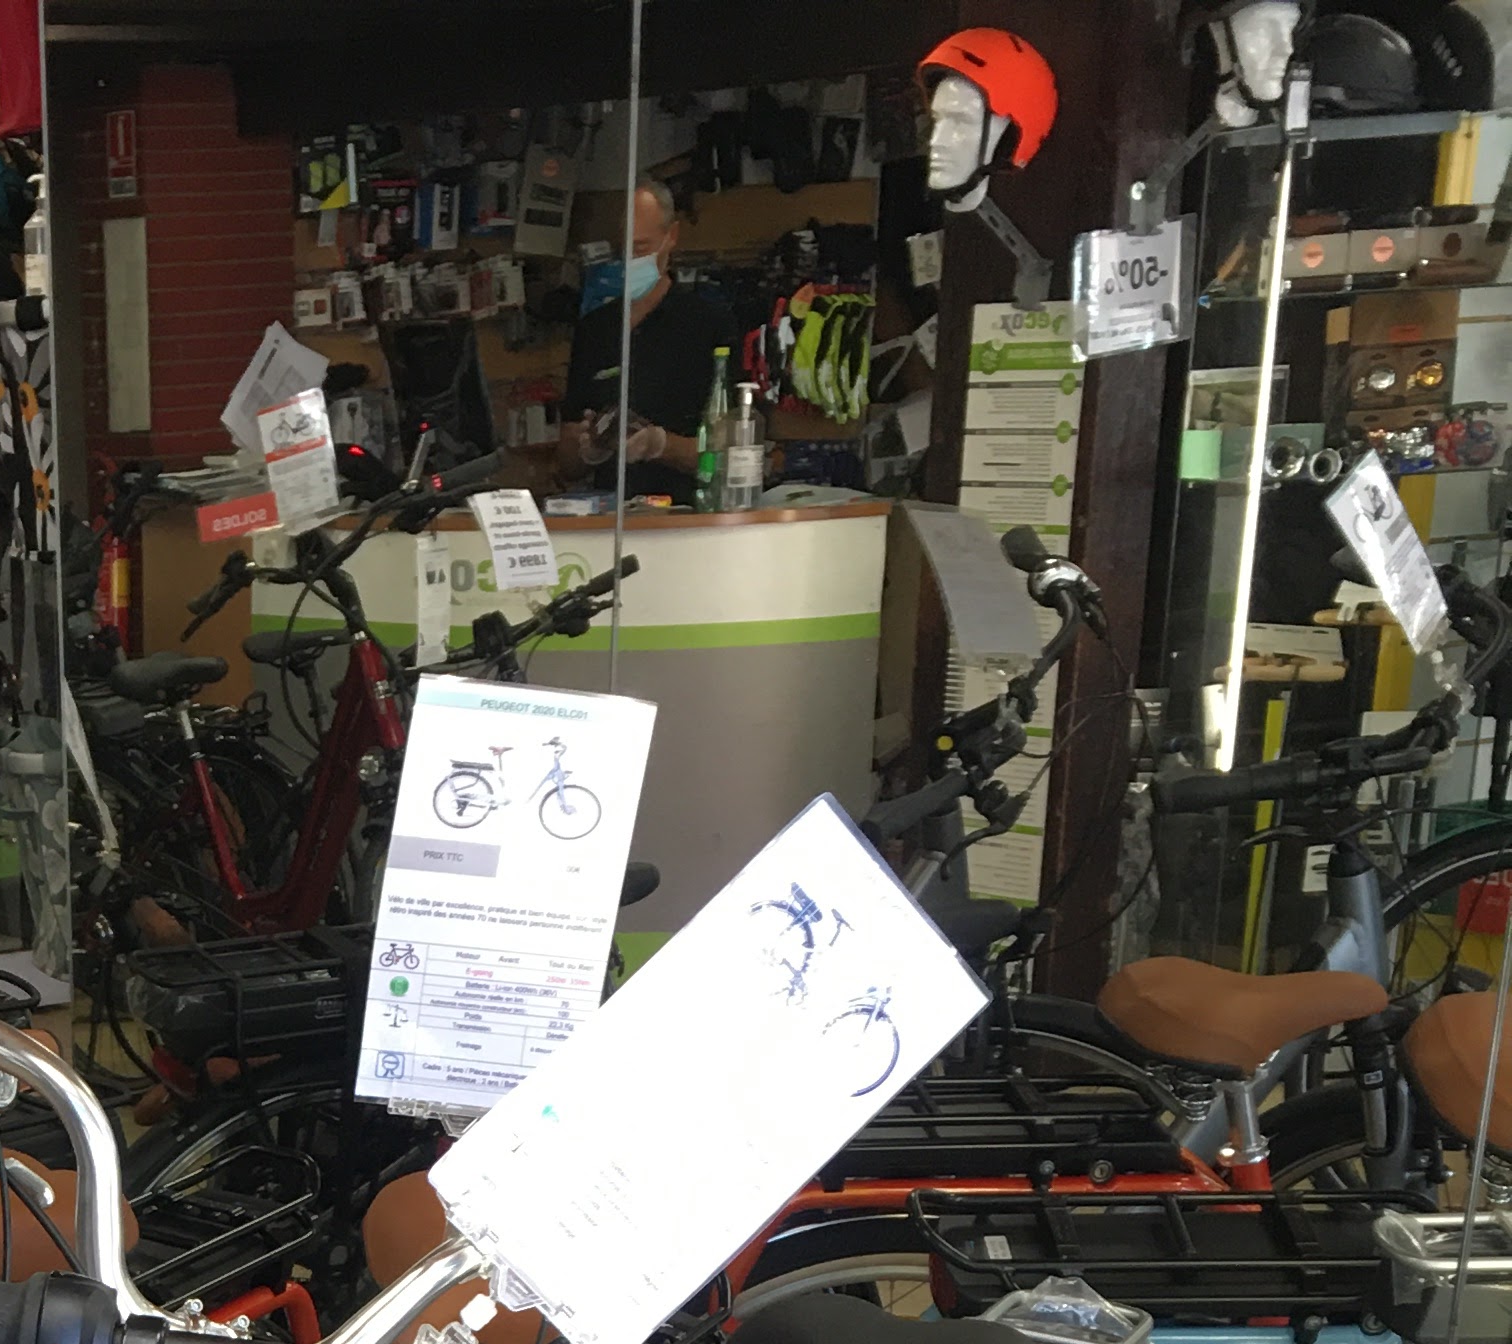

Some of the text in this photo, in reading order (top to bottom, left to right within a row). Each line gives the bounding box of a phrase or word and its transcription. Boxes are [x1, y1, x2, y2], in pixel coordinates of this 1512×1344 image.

[480, 698, 588, 720] PEUGEOT 2020 ELC01
[423, 849, 464, 862] PRIX TTC
